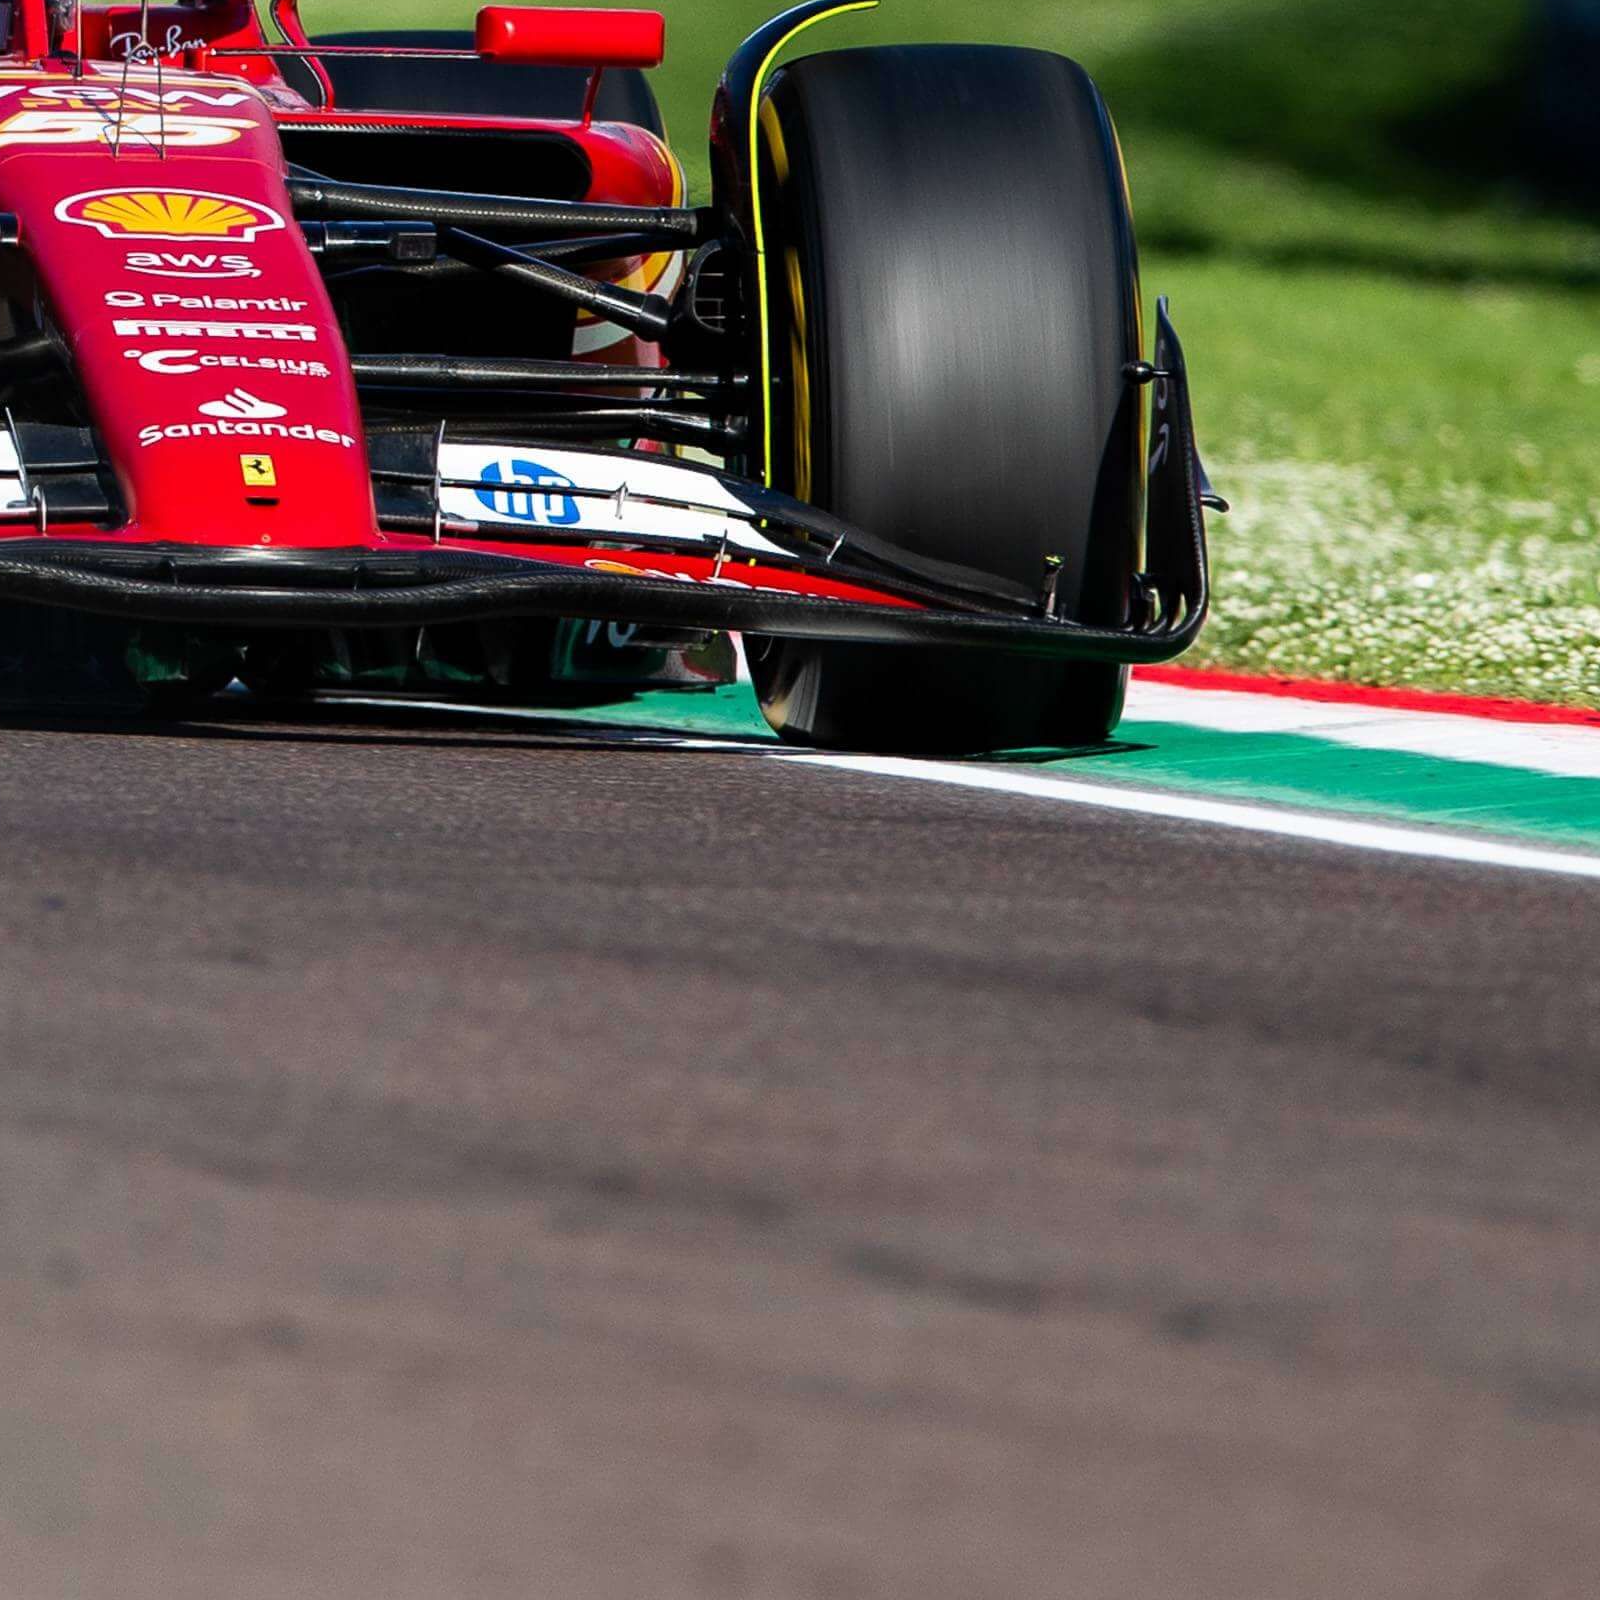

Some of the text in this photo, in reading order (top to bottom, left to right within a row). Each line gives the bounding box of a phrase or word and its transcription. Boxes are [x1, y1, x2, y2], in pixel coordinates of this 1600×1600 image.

[110, 24, 207, 67] Ray-Ban
[20, 97, 194, 112] PLAY
[125, 252, 255, 270] aws
[151, 293, 308, 312] Palantir
[112, 319, 317, 342] PIRELLI
[199, 355, 330, 372] CELSIUS
[138, 419, 356, 447] Santander
[480, 458, 578, 523] hp
